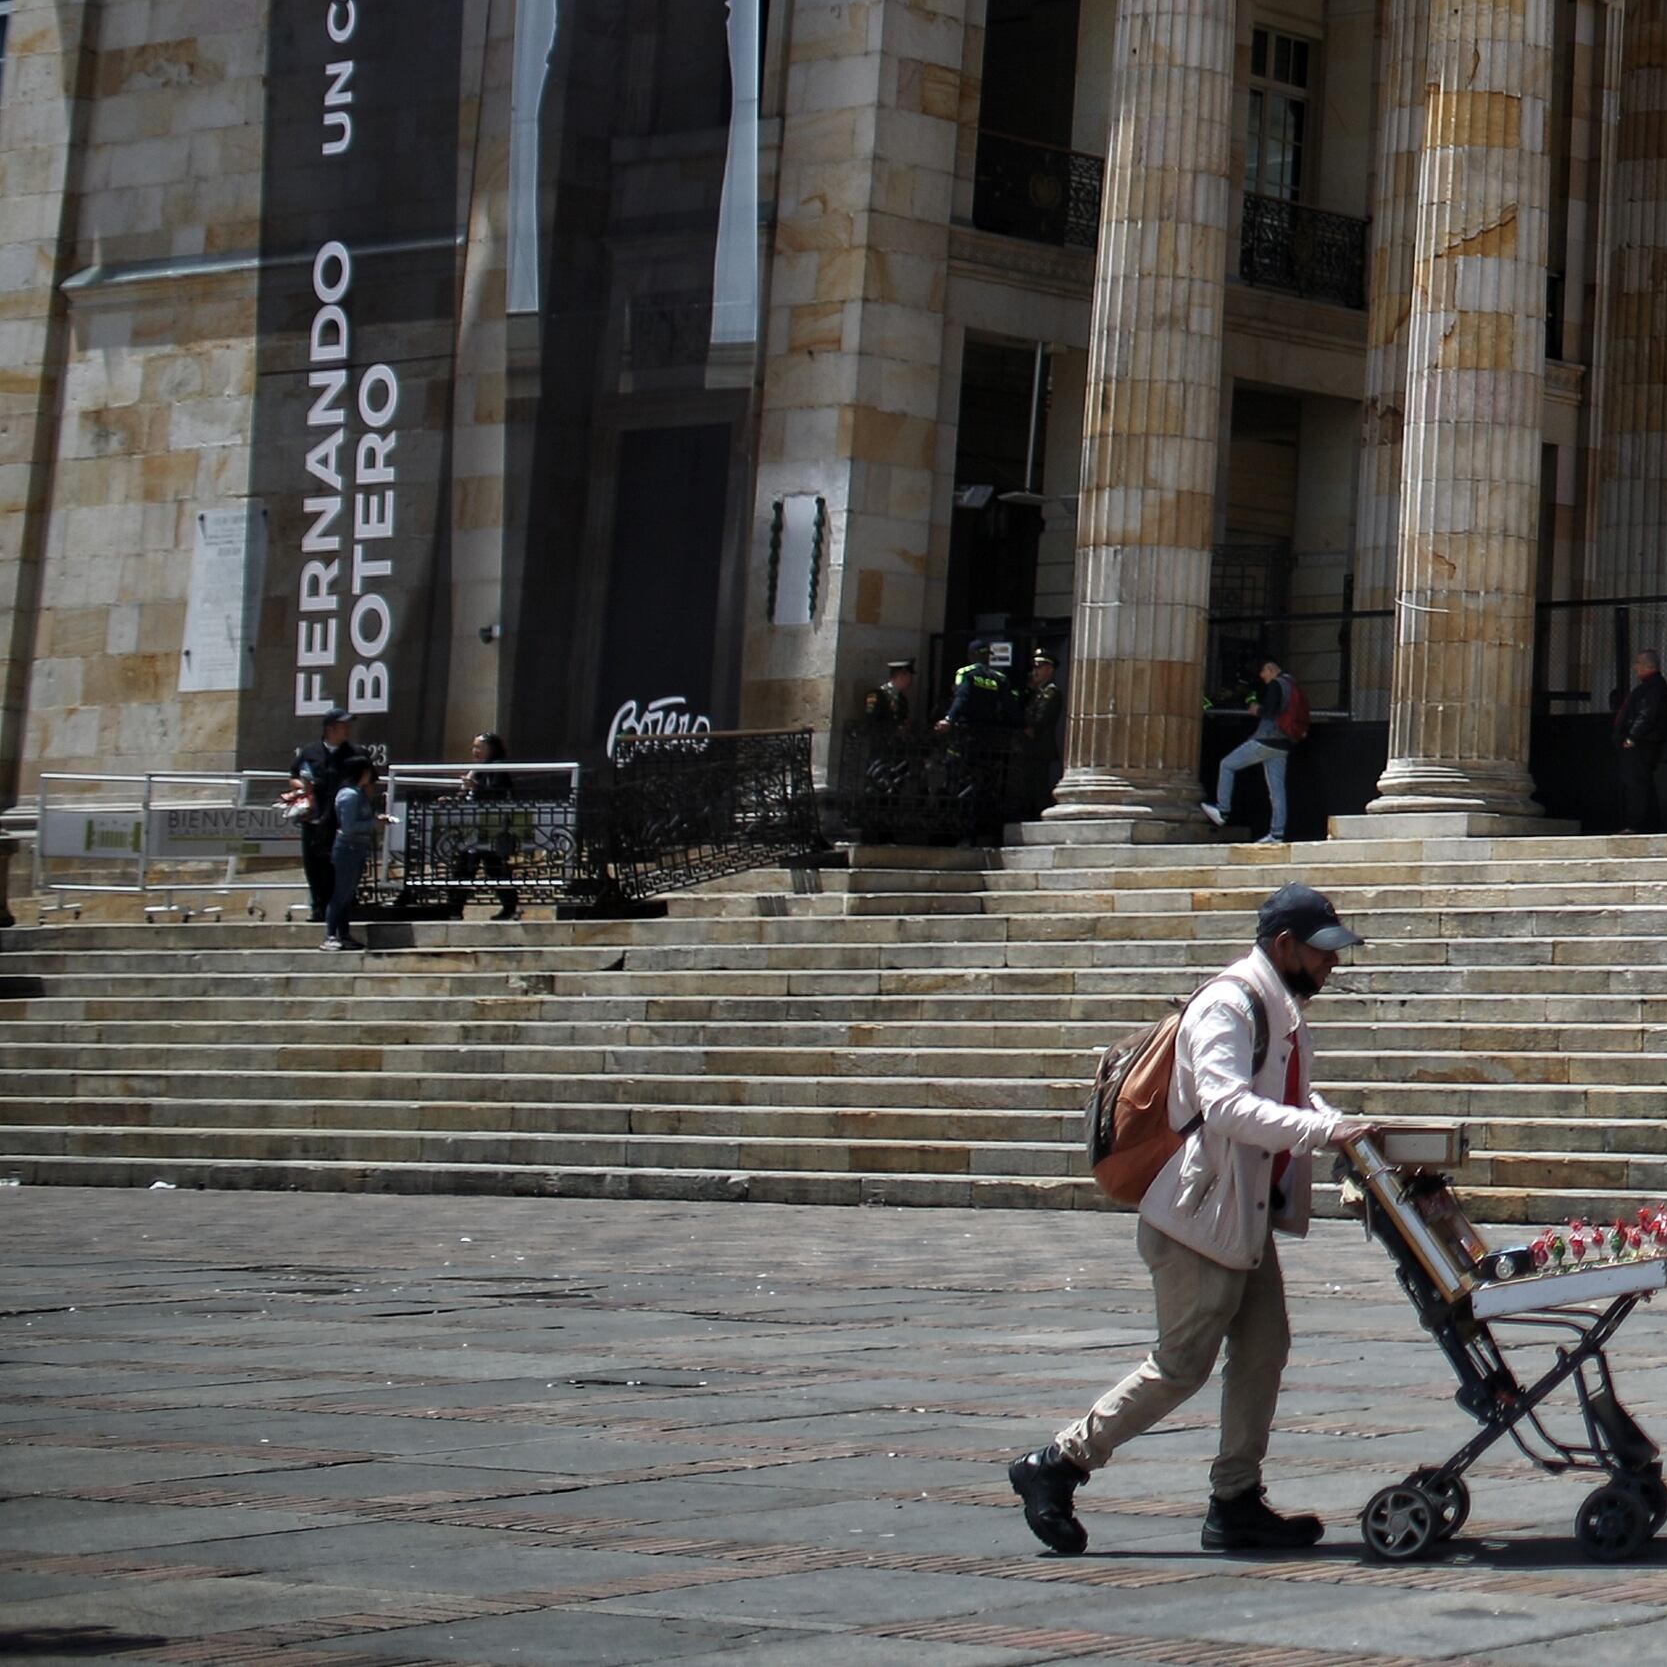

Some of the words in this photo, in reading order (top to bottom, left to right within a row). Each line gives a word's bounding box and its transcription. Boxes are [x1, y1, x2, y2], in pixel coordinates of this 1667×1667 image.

[322, 60, 353, 155] UN
[294, 240, 350, 717] FERNANDO
[348, 363, 399, 714] BOTERO
